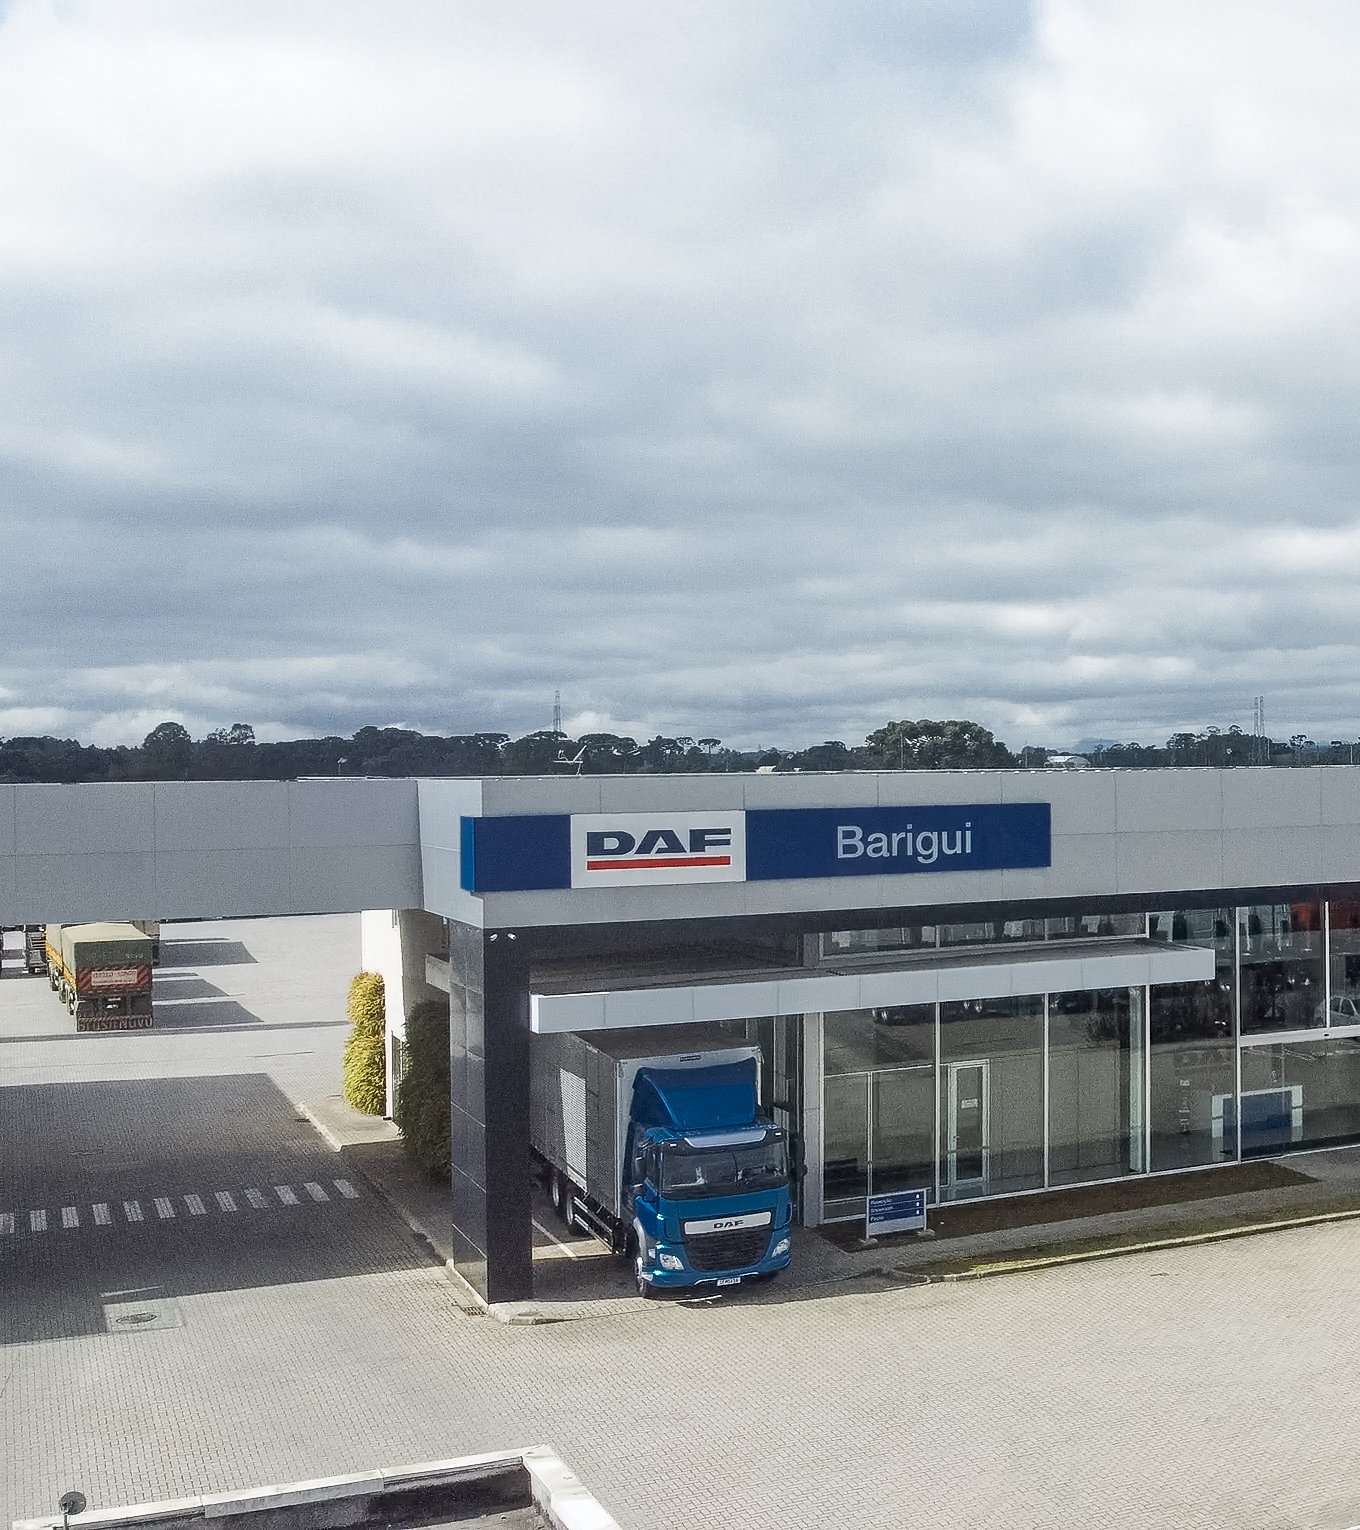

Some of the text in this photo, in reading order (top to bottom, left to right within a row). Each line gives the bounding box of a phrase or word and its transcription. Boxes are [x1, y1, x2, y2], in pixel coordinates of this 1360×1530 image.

[586, 827, 732, 857] DAF
[836, 821, 972, 864] Barigui
[713, 1219, 745, 1229] DAF
